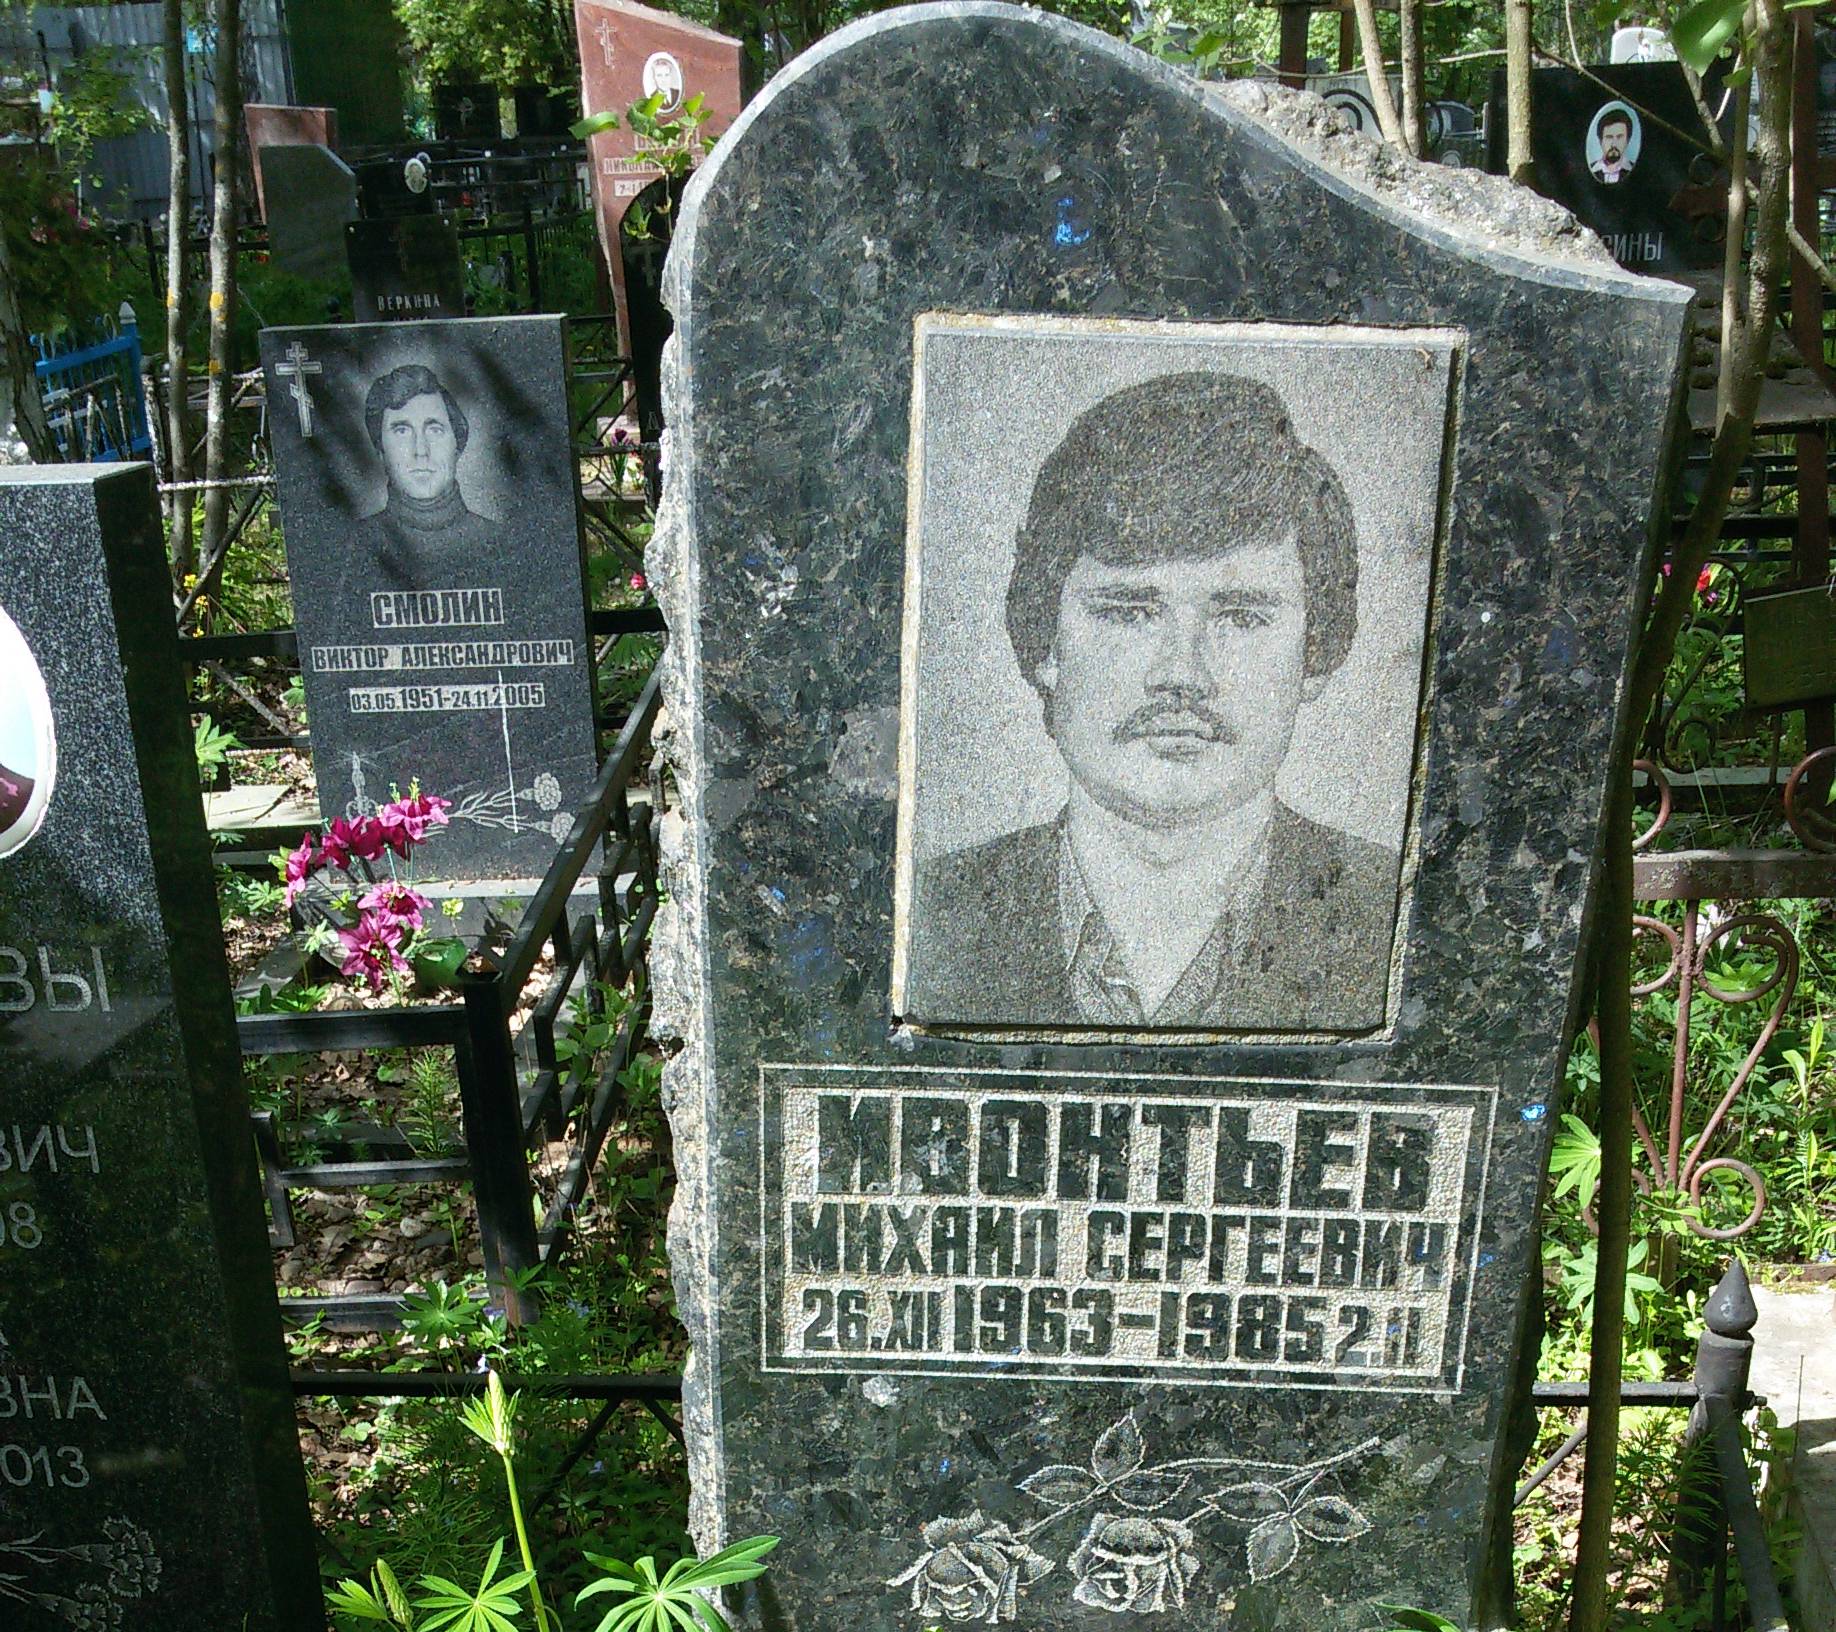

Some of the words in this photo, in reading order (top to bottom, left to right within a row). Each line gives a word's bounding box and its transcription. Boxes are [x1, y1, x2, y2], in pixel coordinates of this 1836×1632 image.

[372, 589, 503, 627] СМОЛИН
[313, 646, 389, 671] ВИКТОР
[401, 640, 573, 668] АЛЕКСАНДРОВИЧ
[0, 1201, 43, 1249] 8
[791, 1201, 1058, 1278] МИХАИЛ
[1086, 1205, 1444, 1291] СЕРГЕЕВИЧ
